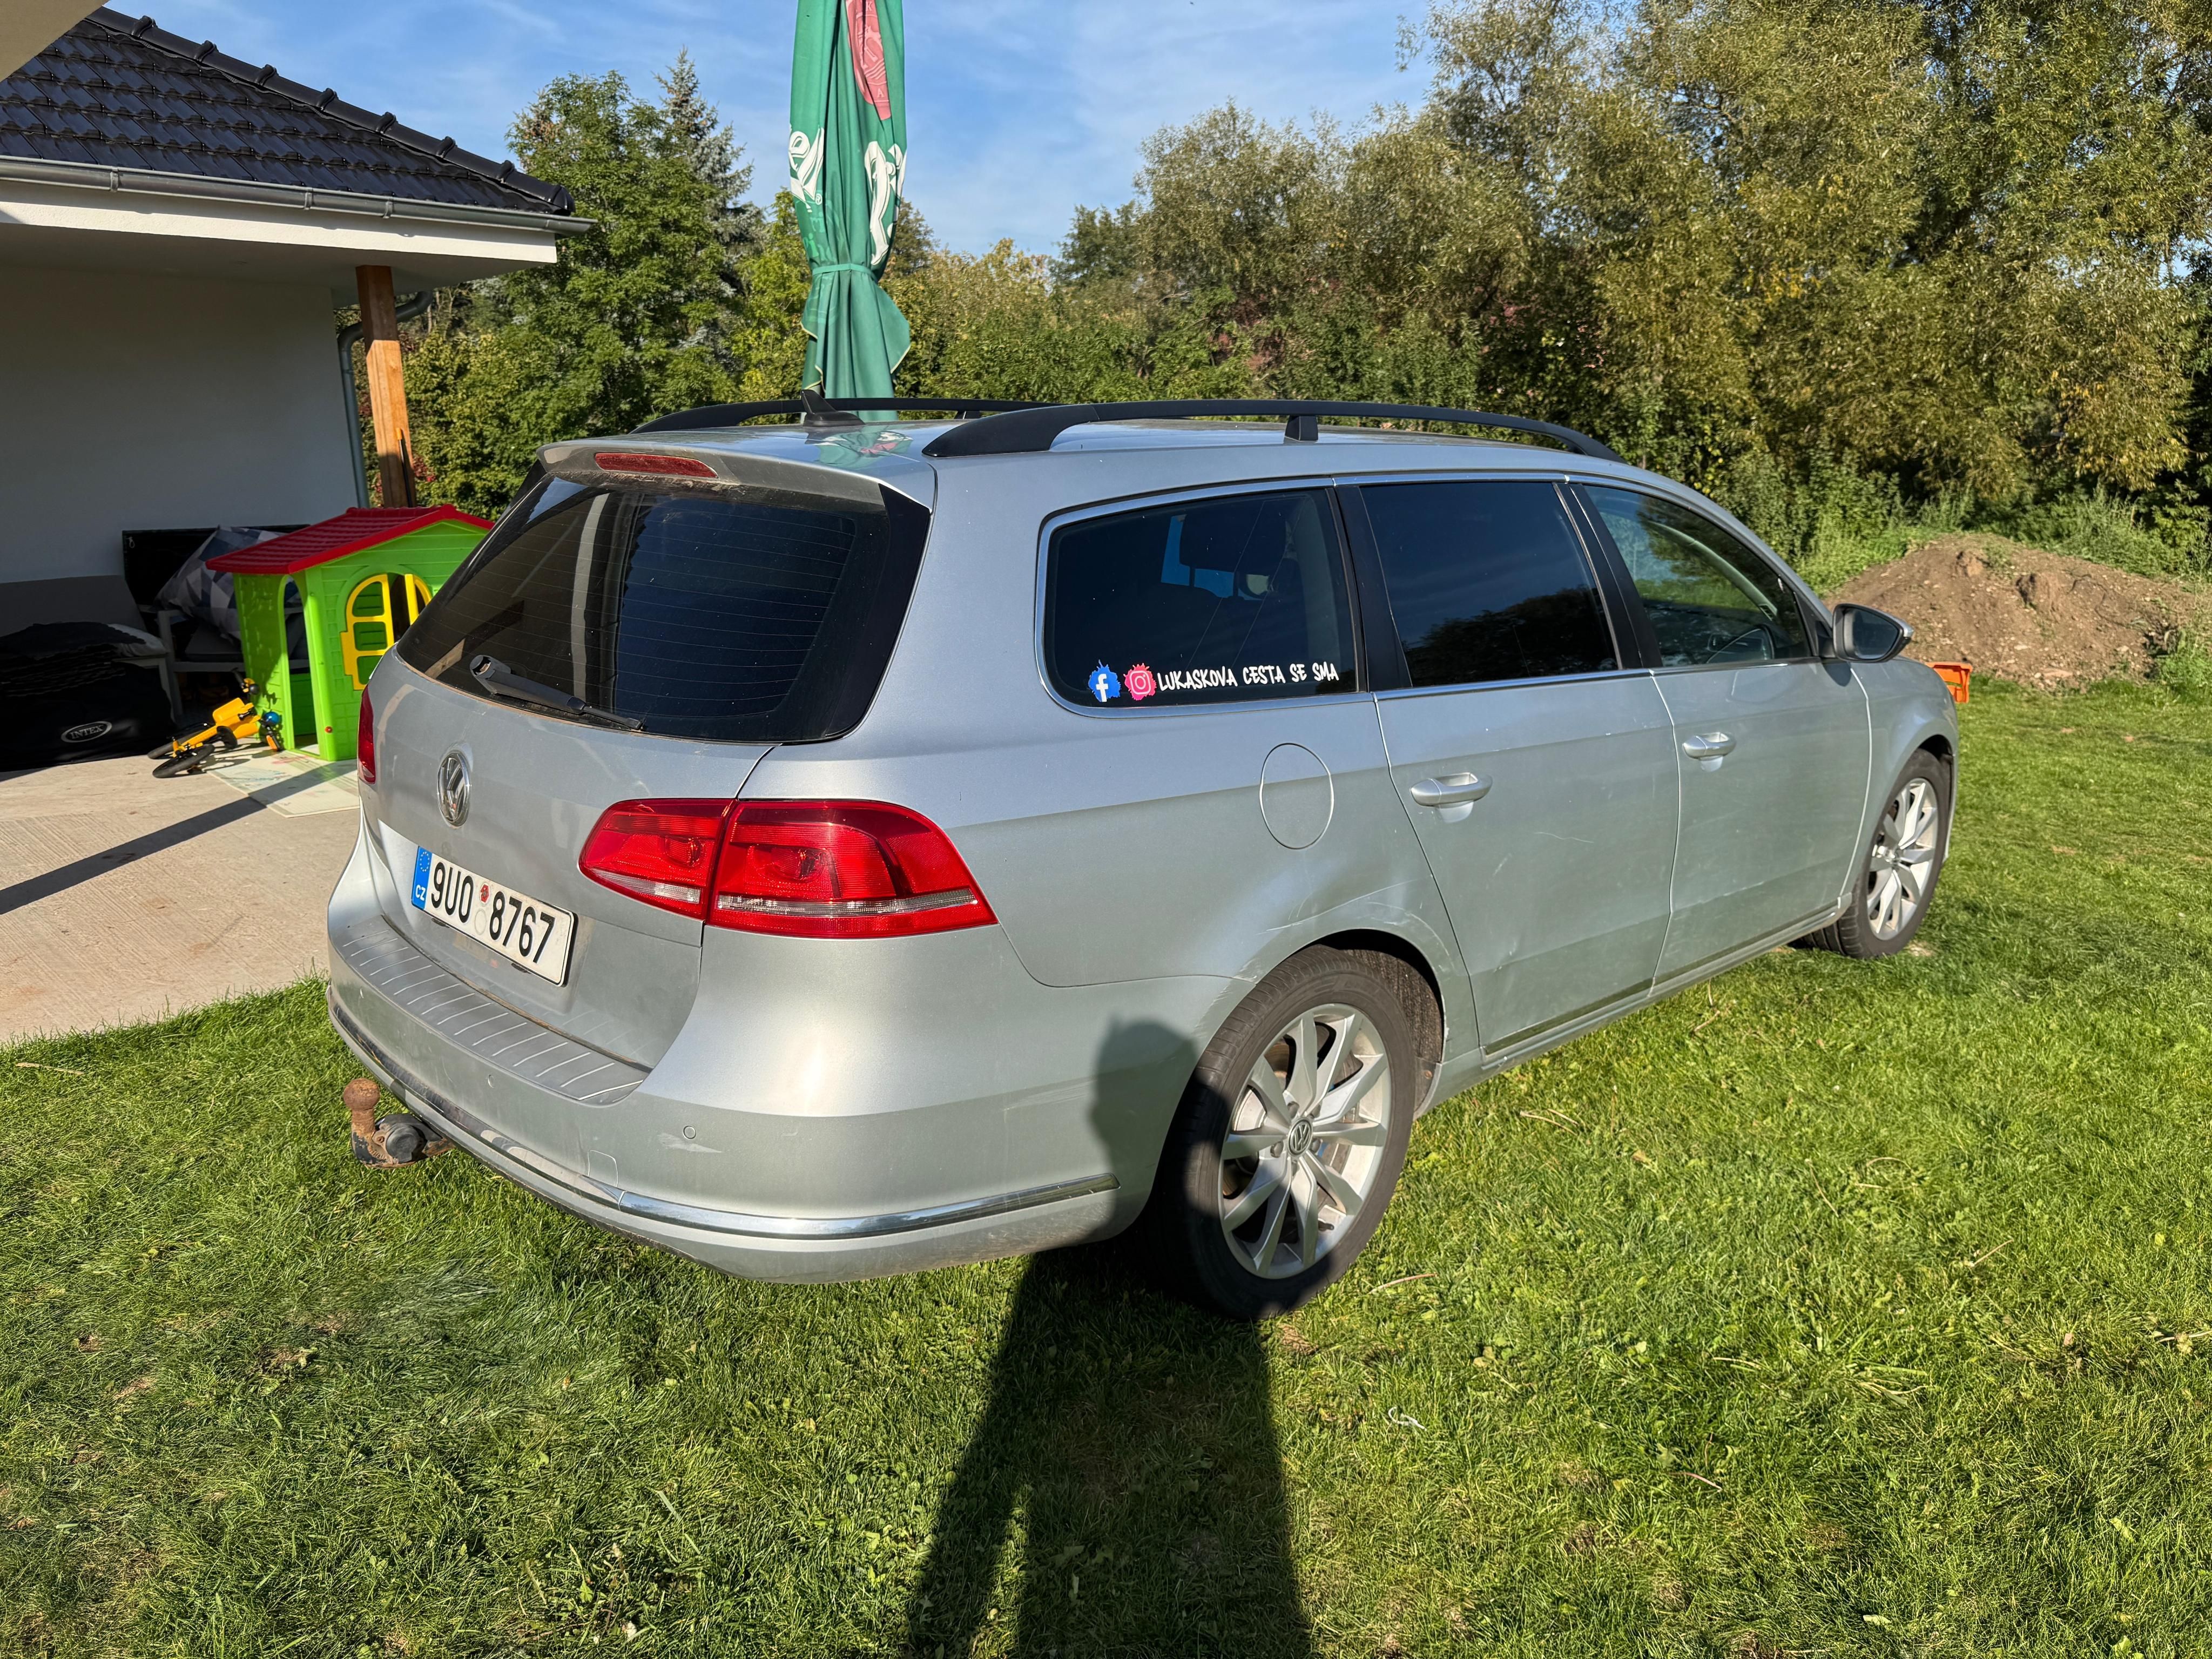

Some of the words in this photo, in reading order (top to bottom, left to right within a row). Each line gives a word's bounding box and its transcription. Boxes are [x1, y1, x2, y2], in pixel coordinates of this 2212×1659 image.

[1157, 665, 1238, 691] LUKASKOVA
[1243, 665, 1286, 685] CESTA
[1290, 663, 1307, 683] SE
[1312, 661, 1340, 682] SMA
[69, 724, 104, 739] INTEX
[415, 884, 426, 901] CZ
[489, 891, 556, 964] 8767
